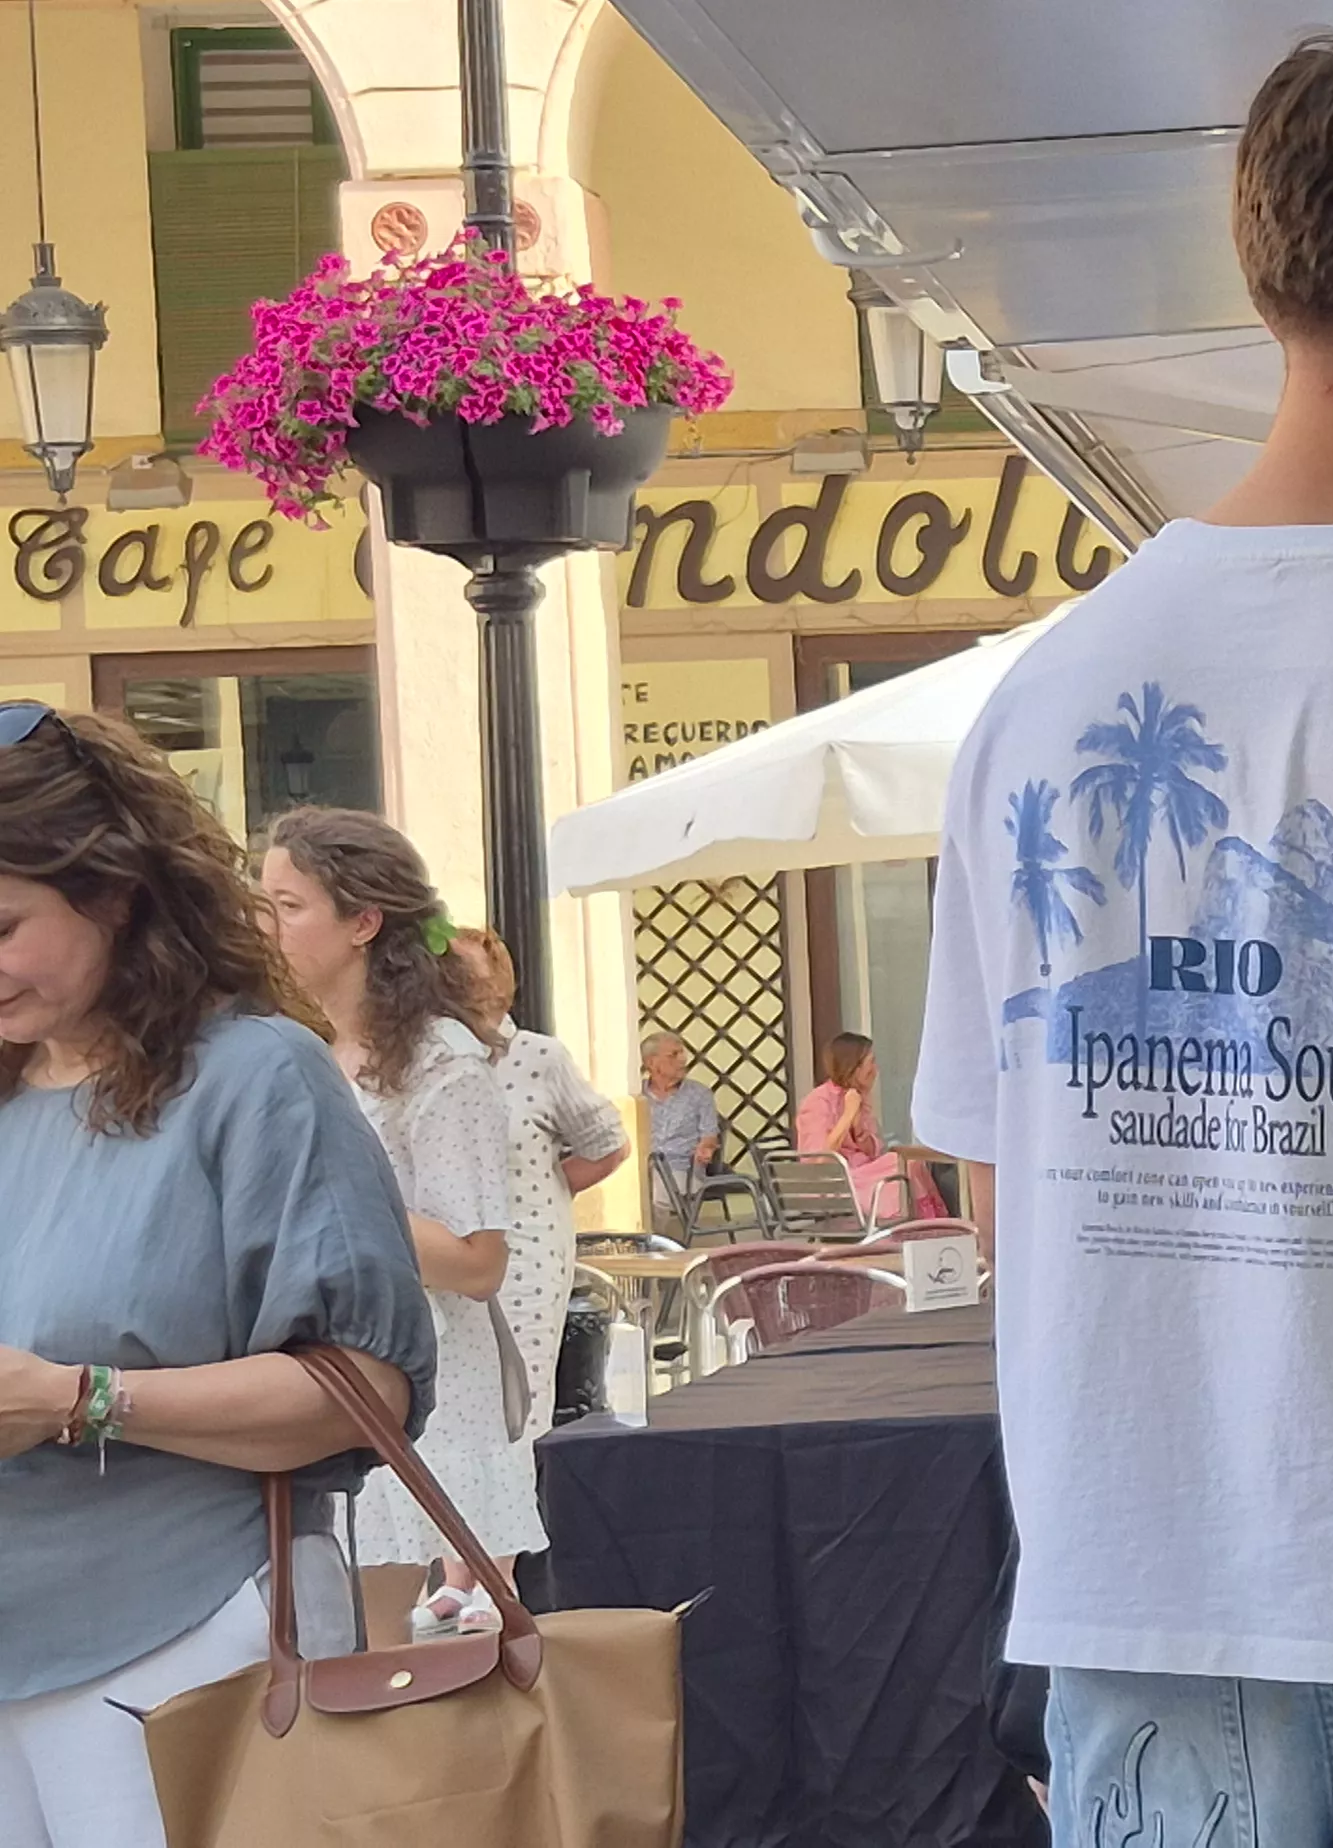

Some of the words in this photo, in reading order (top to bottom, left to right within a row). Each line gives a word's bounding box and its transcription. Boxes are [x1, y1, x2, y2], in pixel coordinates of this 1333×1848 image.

[1148, 935, 1283, 997] RIO
[1066, 1005, 1254, 1119] Ipanema
[1109, 1096, 1221, 1151] saudade
[1224, 1099, 1248, 1152] for
[1252, 1104, 1326, 1157] Brazil
